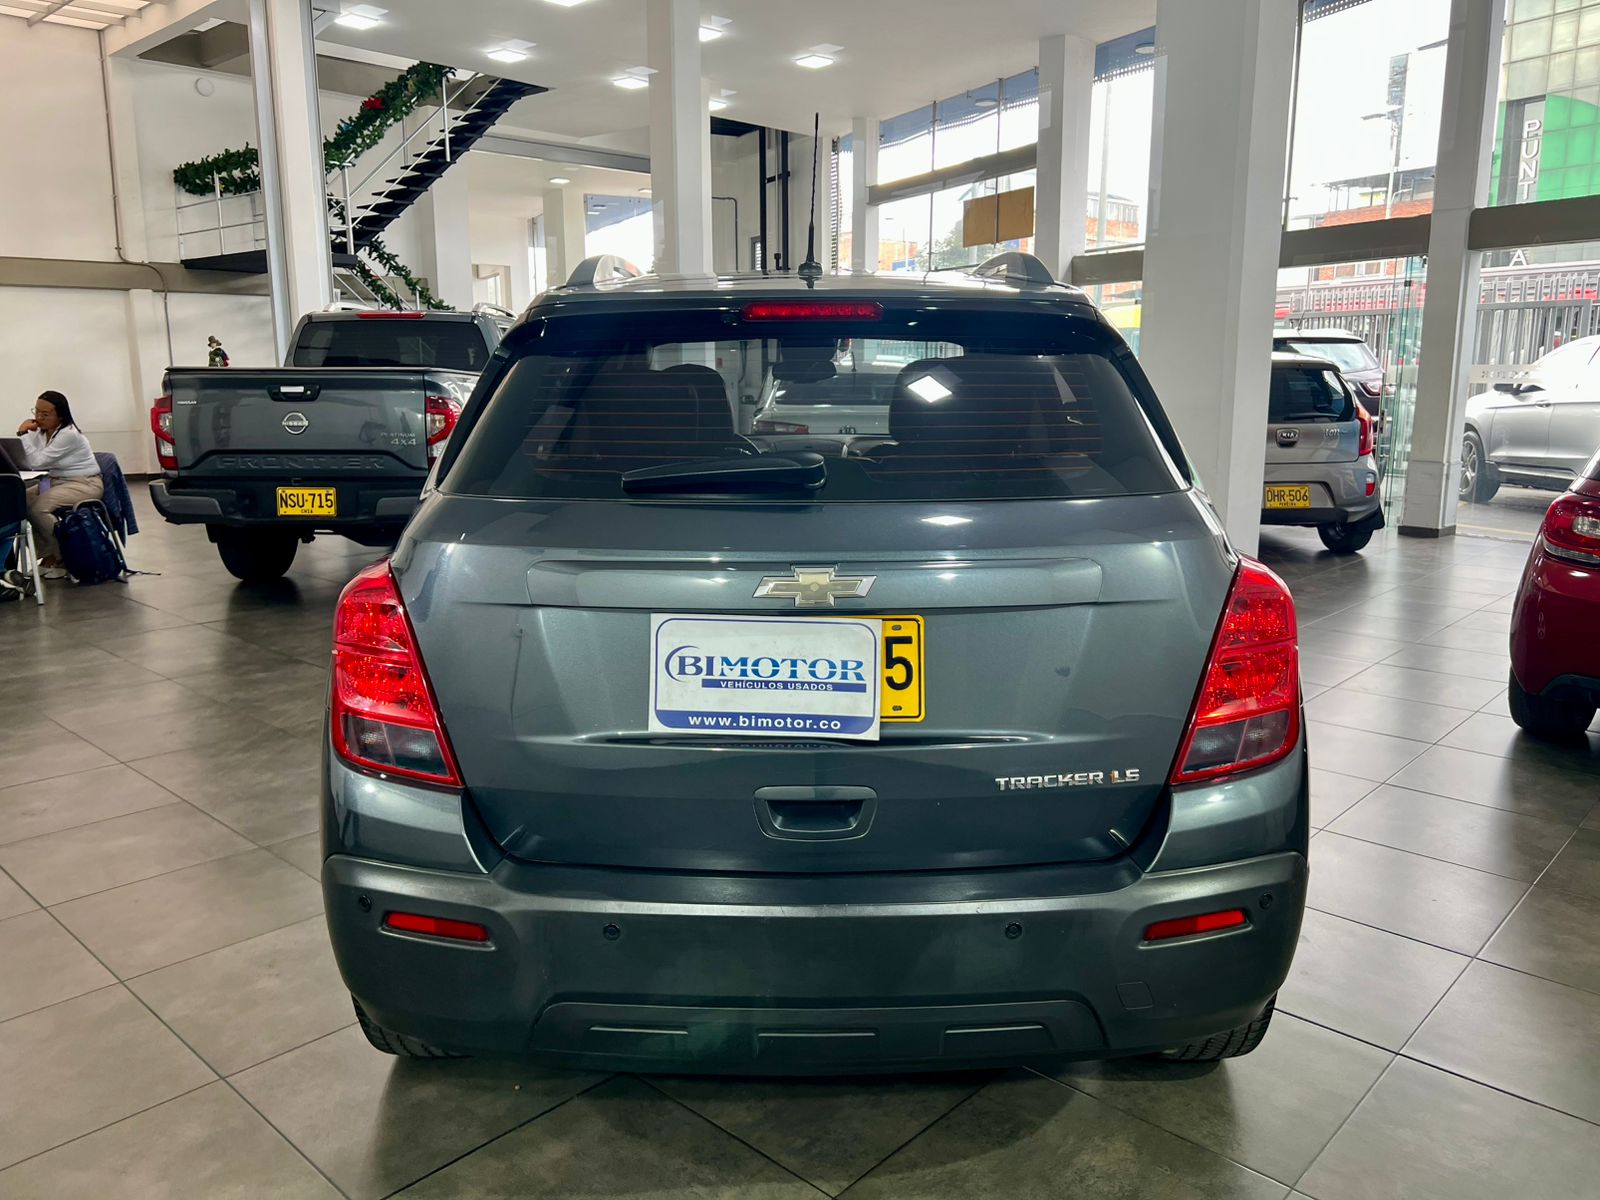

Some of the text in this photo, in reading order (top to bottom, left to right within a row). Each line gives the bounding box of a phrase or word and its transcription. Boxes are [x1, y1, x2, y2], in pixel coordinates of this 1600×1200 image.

[217, 456, 386, 470] FRONTIER
[787, 682, 834, 692] USADOS
[687, 714, 842, 731] www.bimotor.co
[994, 772, 1104, 792] TRACKER
